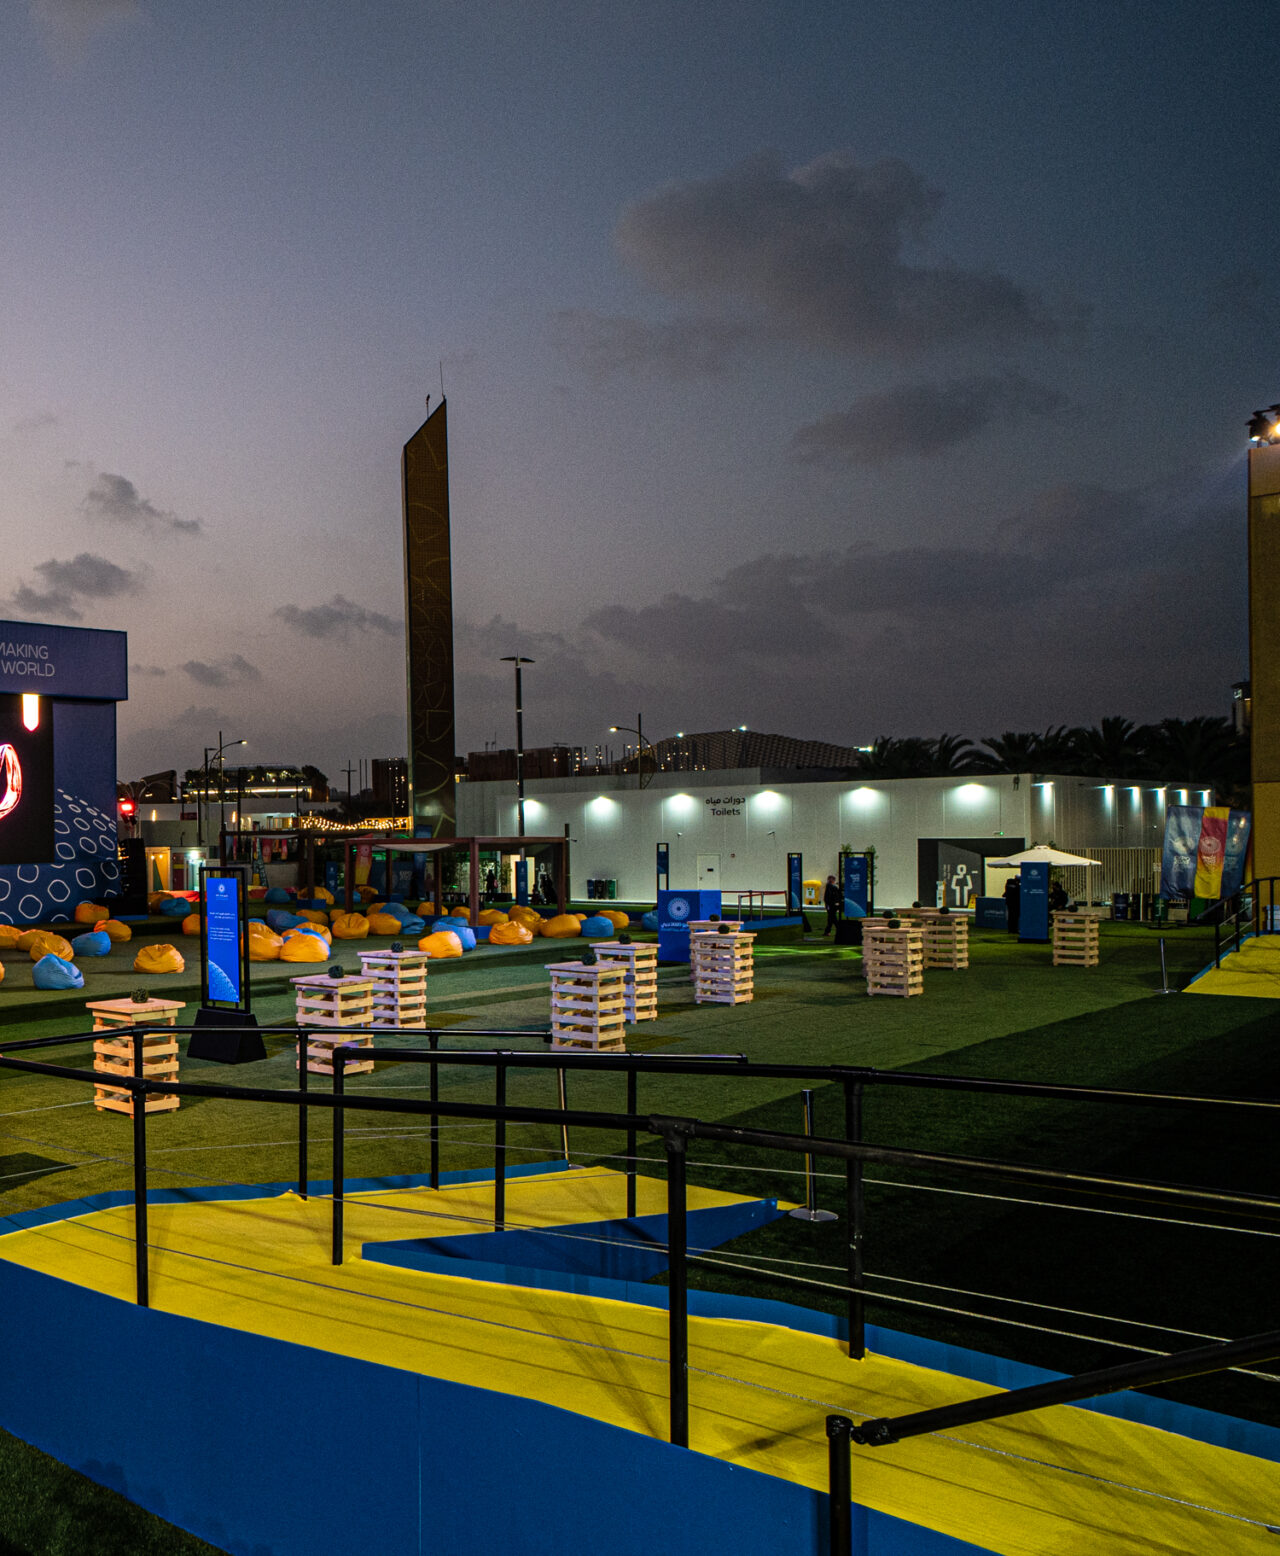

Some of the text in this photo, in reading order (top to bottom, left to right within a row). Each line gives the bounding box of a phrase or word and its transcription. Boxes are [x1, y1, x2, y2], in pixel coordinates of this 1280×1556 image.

[1, 659, 56, 677] WORLD
[705, 796, 746, 806] دورات مياه
[711, 808, 741, 816] Toilets
